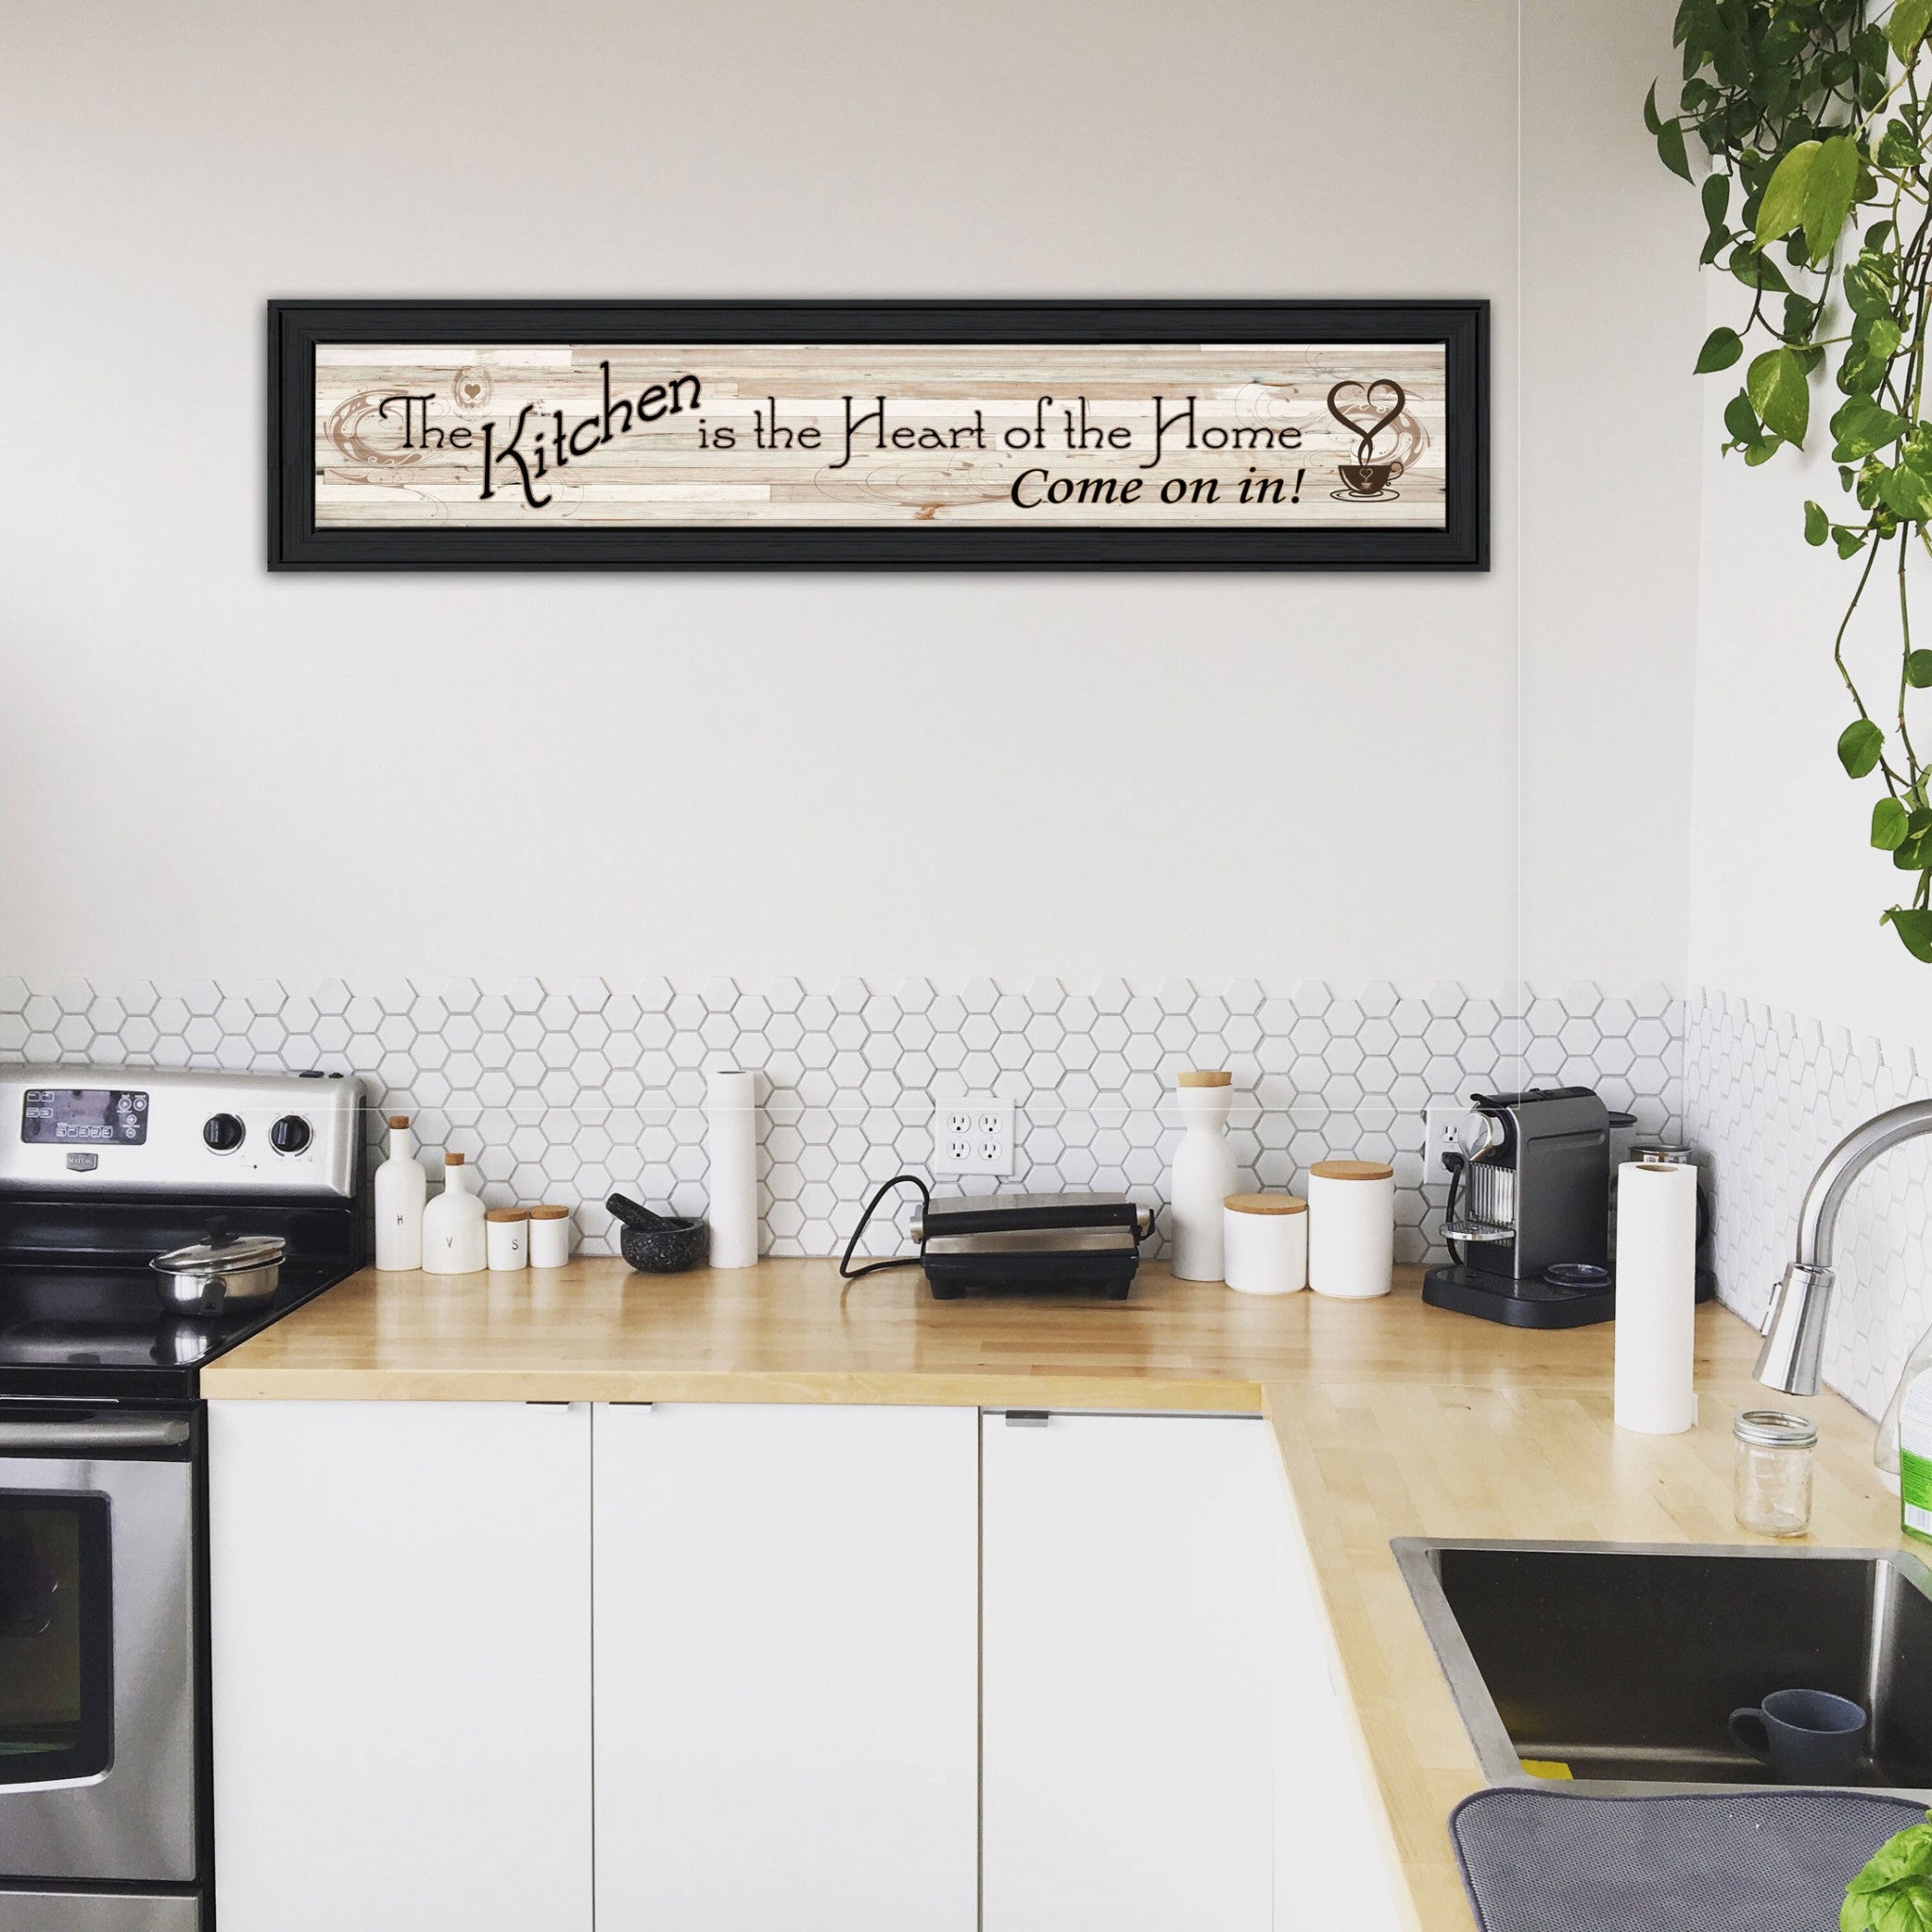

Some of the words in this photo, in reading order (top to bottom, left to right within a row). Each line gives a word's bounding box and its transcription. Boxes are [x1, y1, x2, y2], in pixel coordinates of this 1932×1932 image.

[378, 392, 473, 449] The
[479, 360, 702, 509] Kitchen
[699, 418, 736, 449] is
[754, 396, 822, 449] the
[828, 395, 986, 469] Heart
[1005, 395, 1053, 449] of
[1064, 396, 1132, 449] the
[1139, 395, 1303, 469] Home
[1010, 468, 1144, 508] Come
[1160, 478, 1221, 505] on
[1238, 466, 1307, 505] in!
[396, 1215, 404, 1224] H
[446, 1238, 453, 1247] V
[511, 1239, 519, 1251] S
